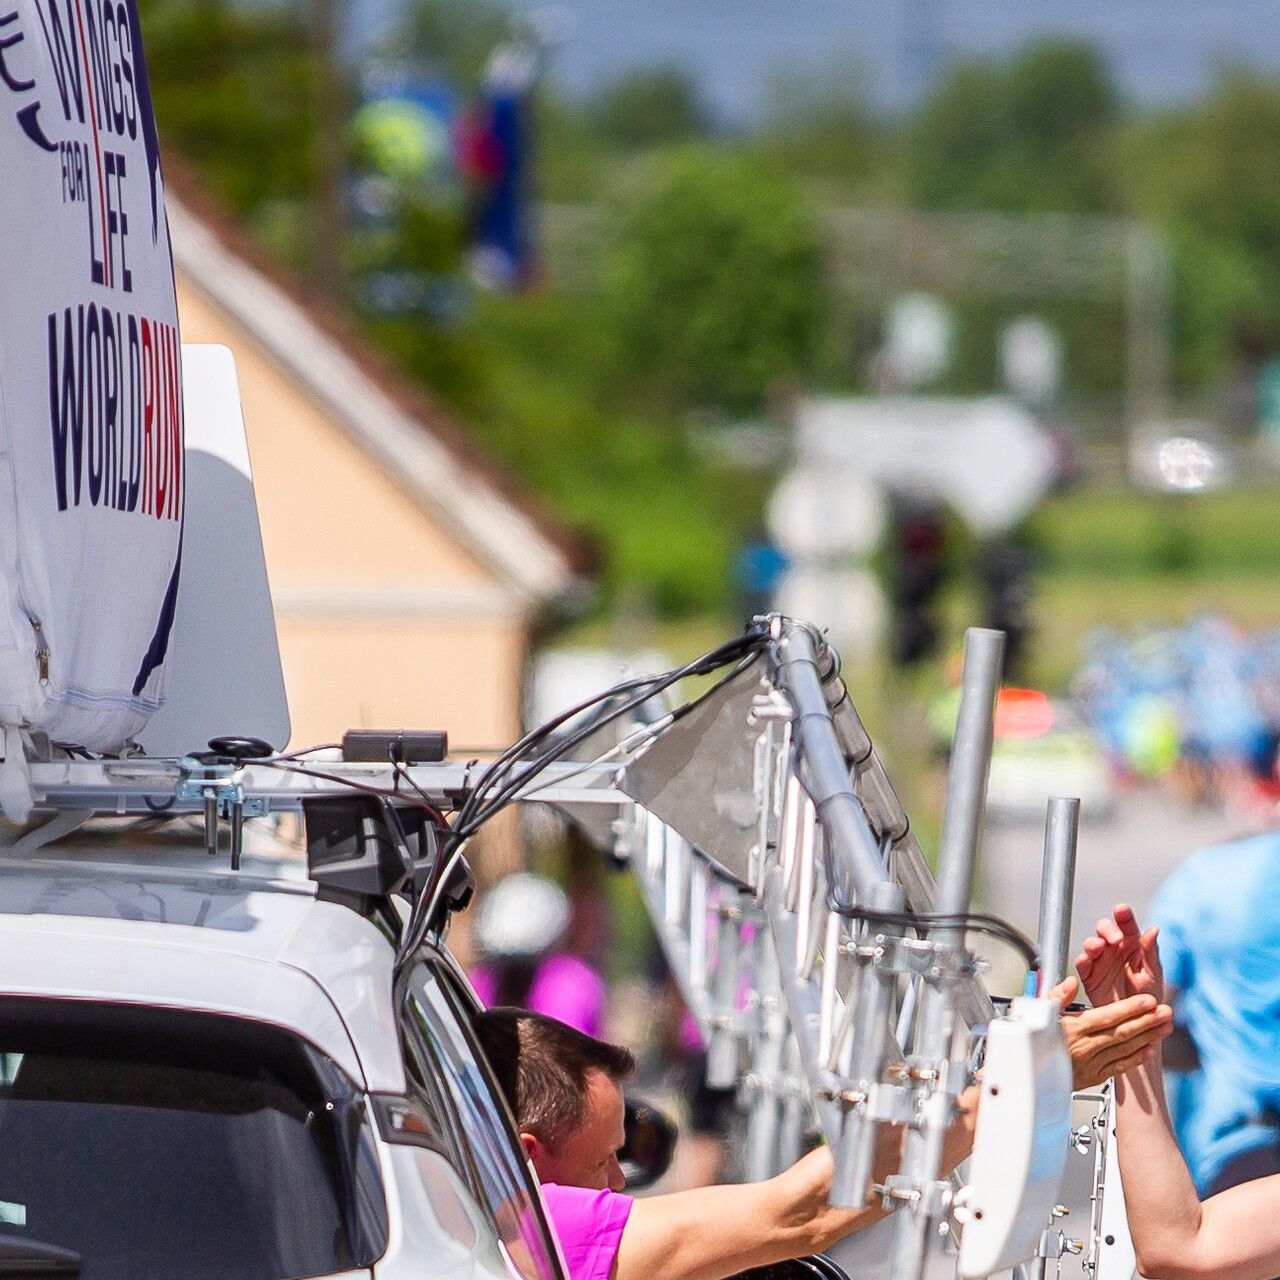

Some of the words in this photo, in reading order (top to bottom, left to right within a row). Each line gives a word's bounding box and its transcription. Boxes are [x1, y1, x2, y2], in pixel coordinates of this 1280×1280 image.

[35, 0, 137, 141] WINGS
[60, 140, 85, 203] FOR
[83, 142, 133, 293] LIFE
